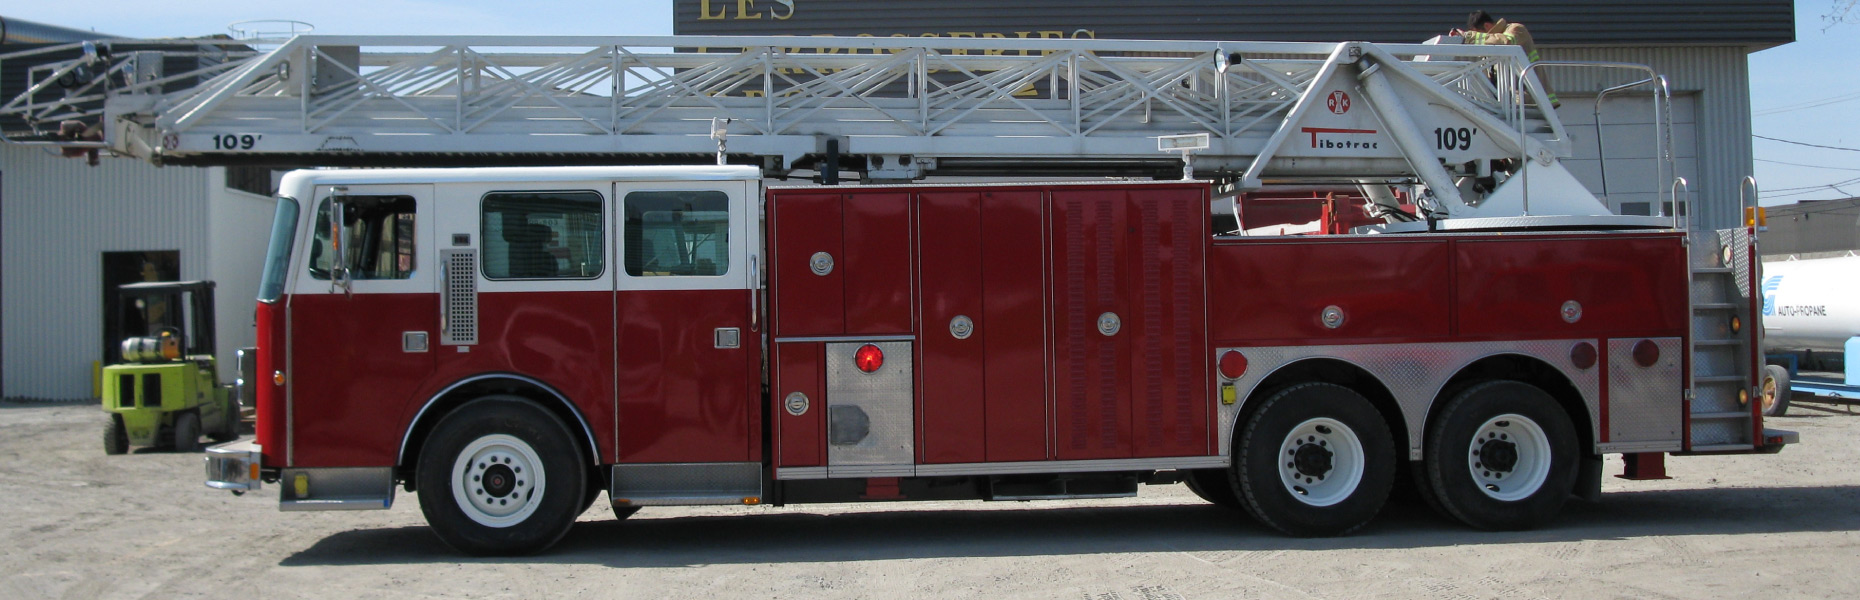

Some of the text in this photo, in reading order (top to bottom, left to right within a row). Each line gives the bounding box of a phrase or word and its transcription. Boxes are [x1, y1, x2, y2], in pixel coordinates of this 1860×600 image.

[697, 0, 795, 20] LES
[212, 134, 262, 150] 109'
[1301, 127, 1378, 149] Tibotrac
[1434, 127, 1477, 151] 109'
[1778, 305, 1827, 316] AUTO-PROPANE
